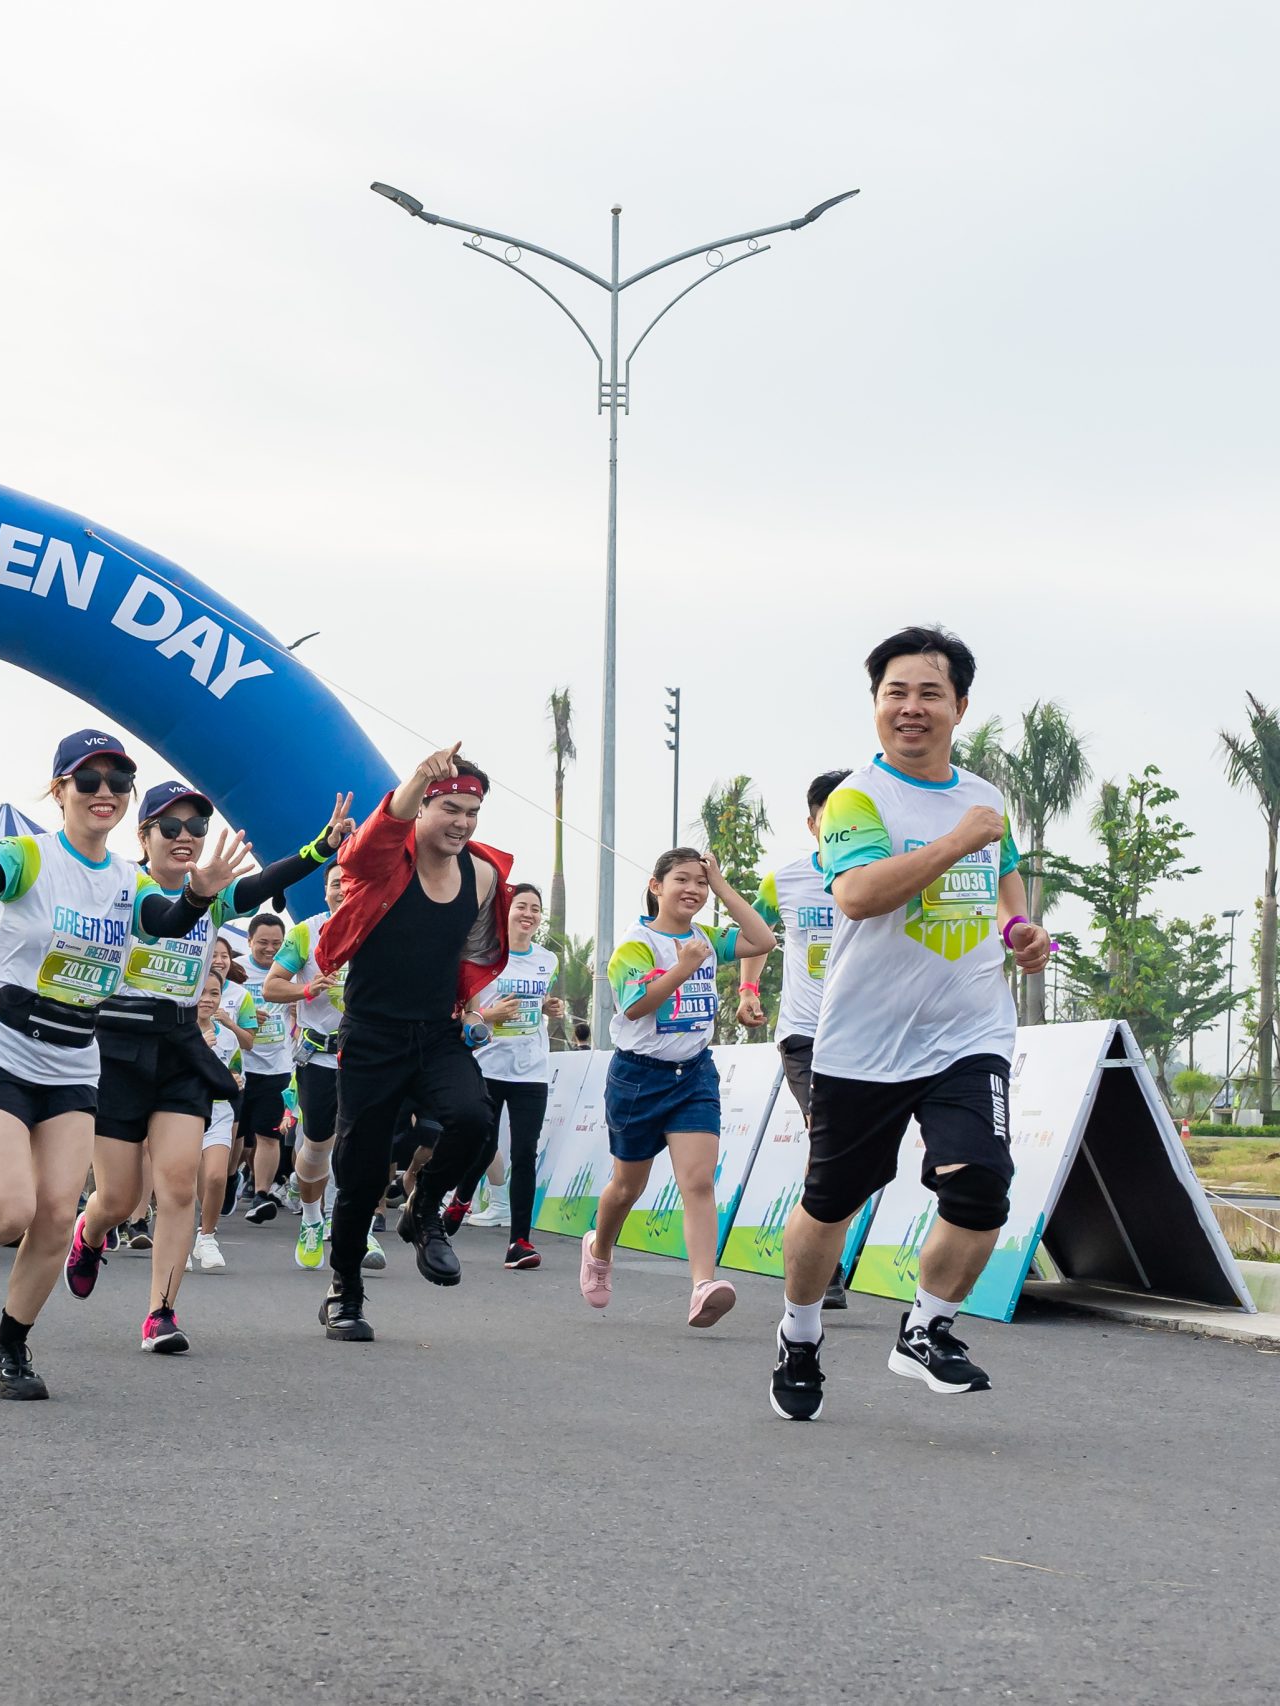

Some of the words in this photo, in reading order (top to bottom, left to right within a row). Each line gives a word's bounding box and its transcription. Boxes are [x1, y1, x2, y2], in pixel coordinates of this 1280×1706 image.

[110, 573, 274, 699] DAY
[824, 828, 851, 844] VIC
[941, 872, 987, 892] 70036
[53, 905, 101, 943] GREEN
[104, 918, 129, 947] DAY
[798, 906, 833, 929] GREE
[61, 959, 102, 983] 70170
[148, 954, 187, 975] 70176
[672, 999, 706, 1013] 10018
